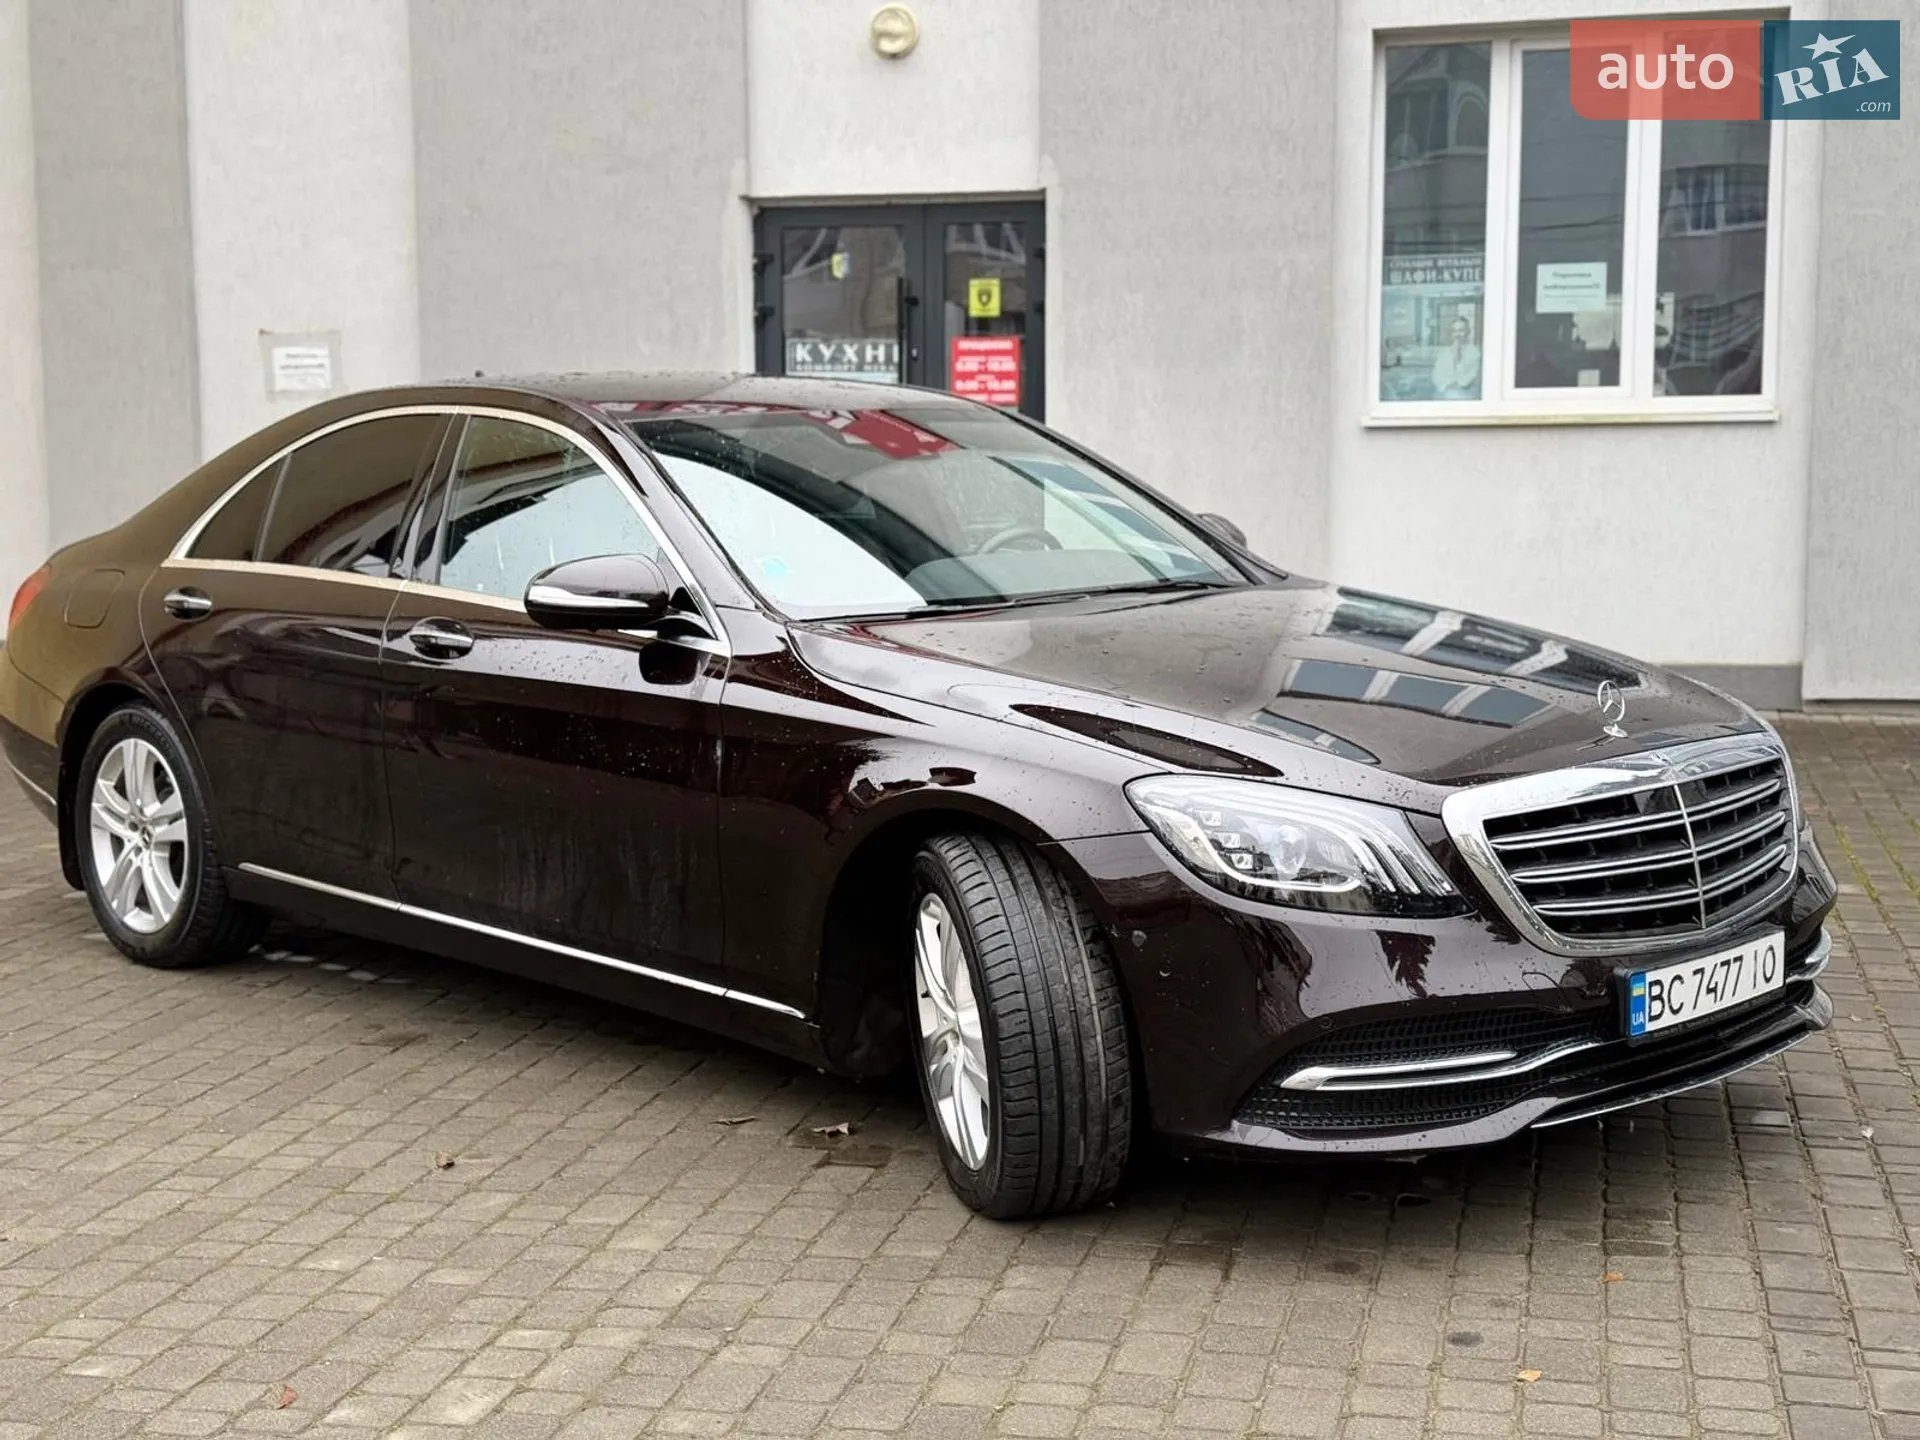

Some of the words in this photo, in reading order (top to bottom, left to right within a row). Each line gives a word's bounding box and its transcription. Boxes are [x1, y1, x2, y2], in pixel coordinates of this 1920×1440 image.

[796, 343, 899, 363] КУХНІ
[1648, 974, 1685, 1022] BC
[1692, 954, 1744, 1011] 7477
[1753, 944, 1776, 989] IO
[1632, 1011, 1645, 1026] UA
